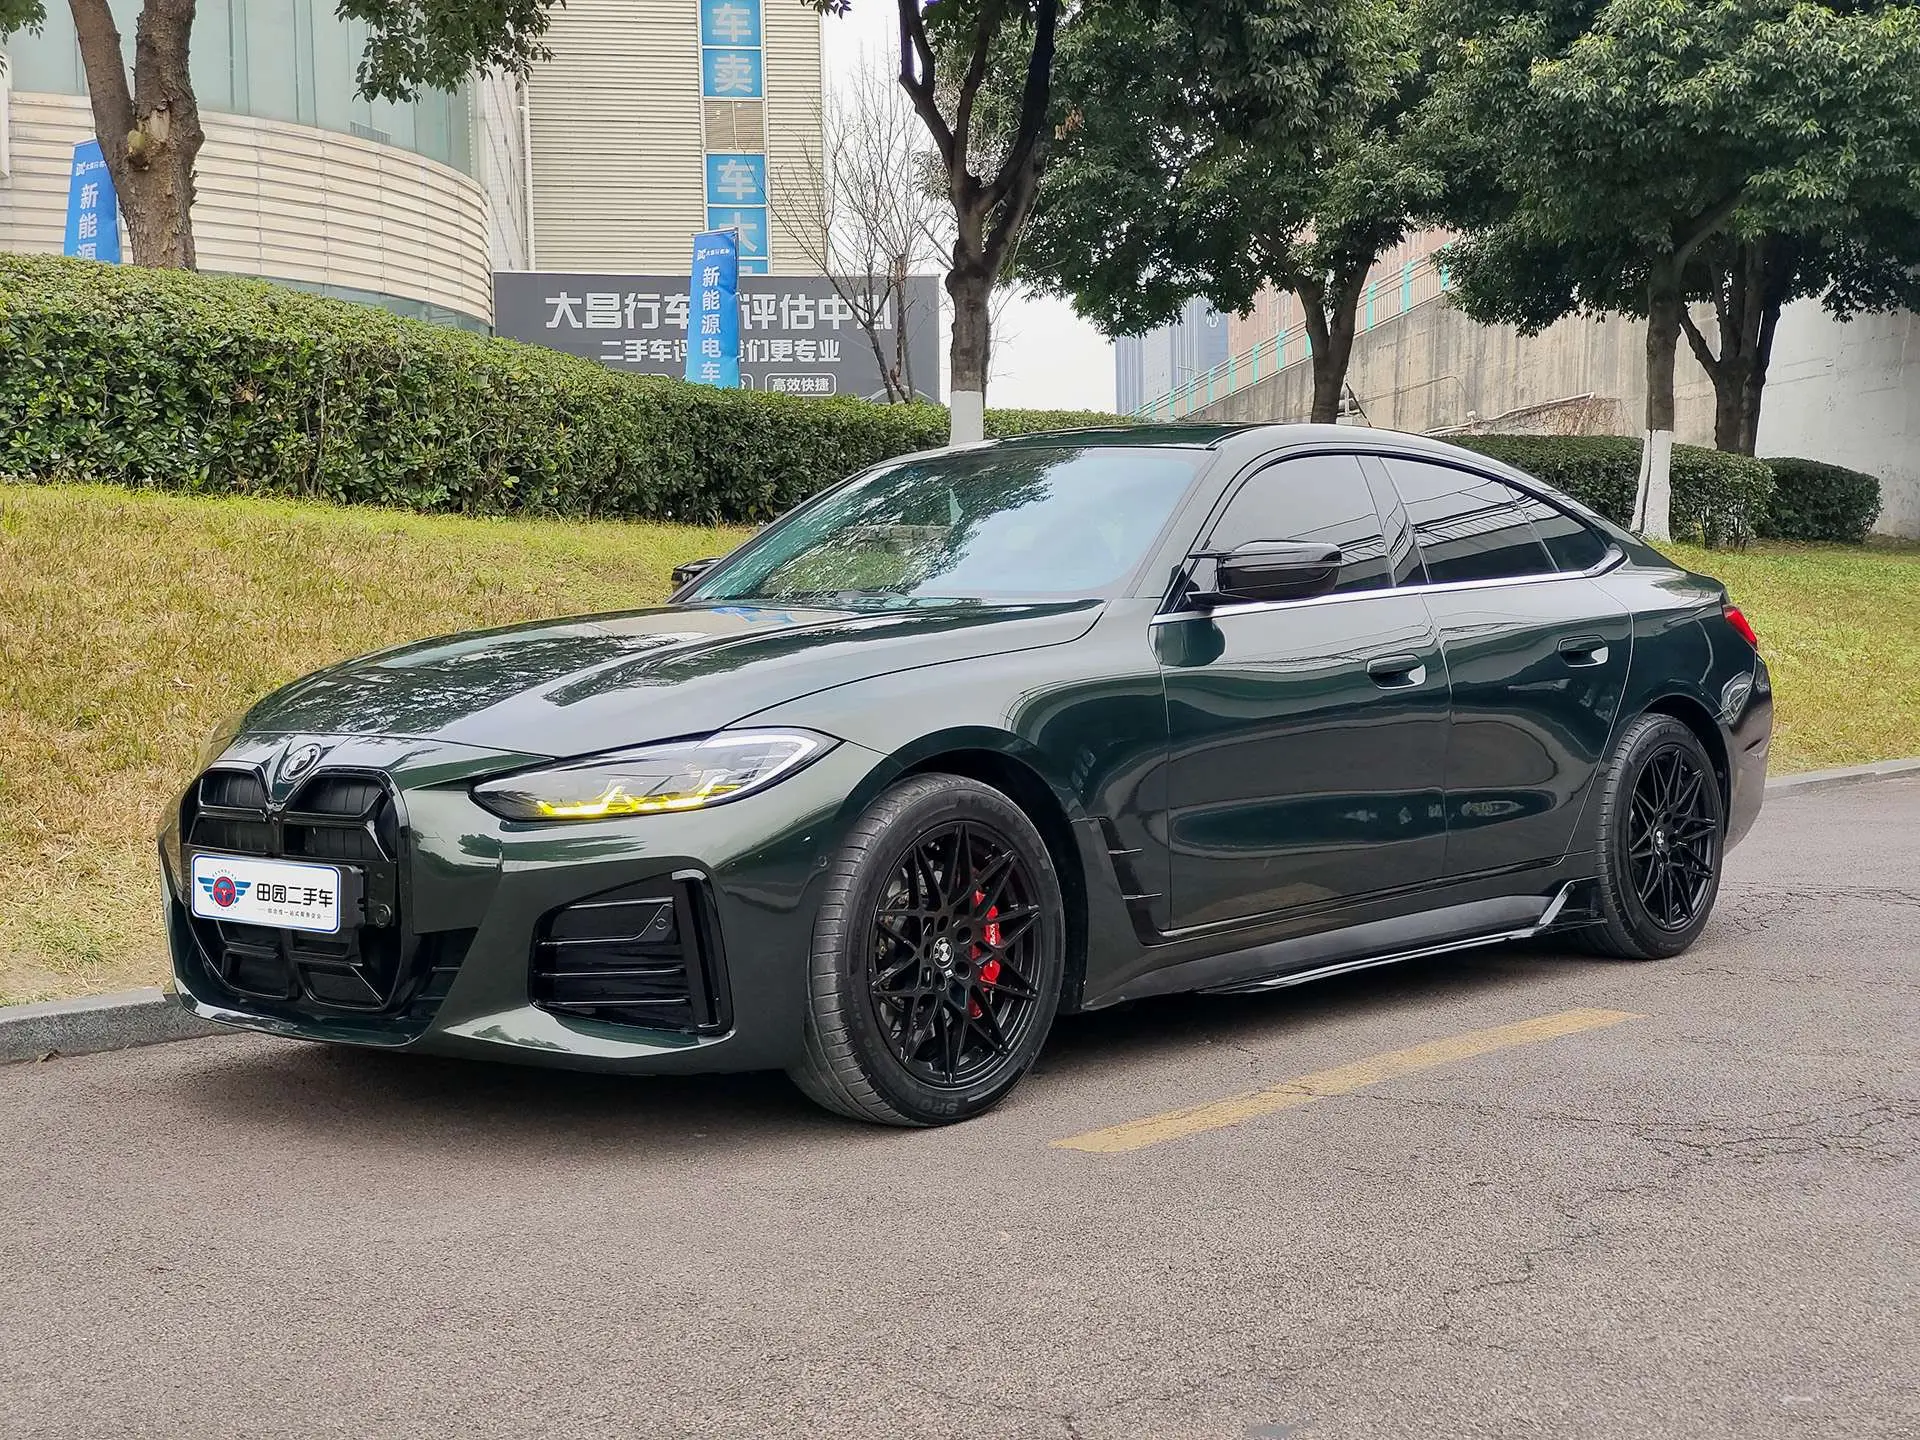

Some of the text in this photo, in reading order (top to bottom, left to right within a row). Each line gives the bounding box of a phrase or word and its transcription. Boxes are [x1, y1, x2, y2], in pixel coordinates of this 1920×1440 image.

[700, 265, 722, 382] 新能源电车
[772, 377, 829, 392] 高效快捷
[256, 883, 333, 908] 田园二手车
